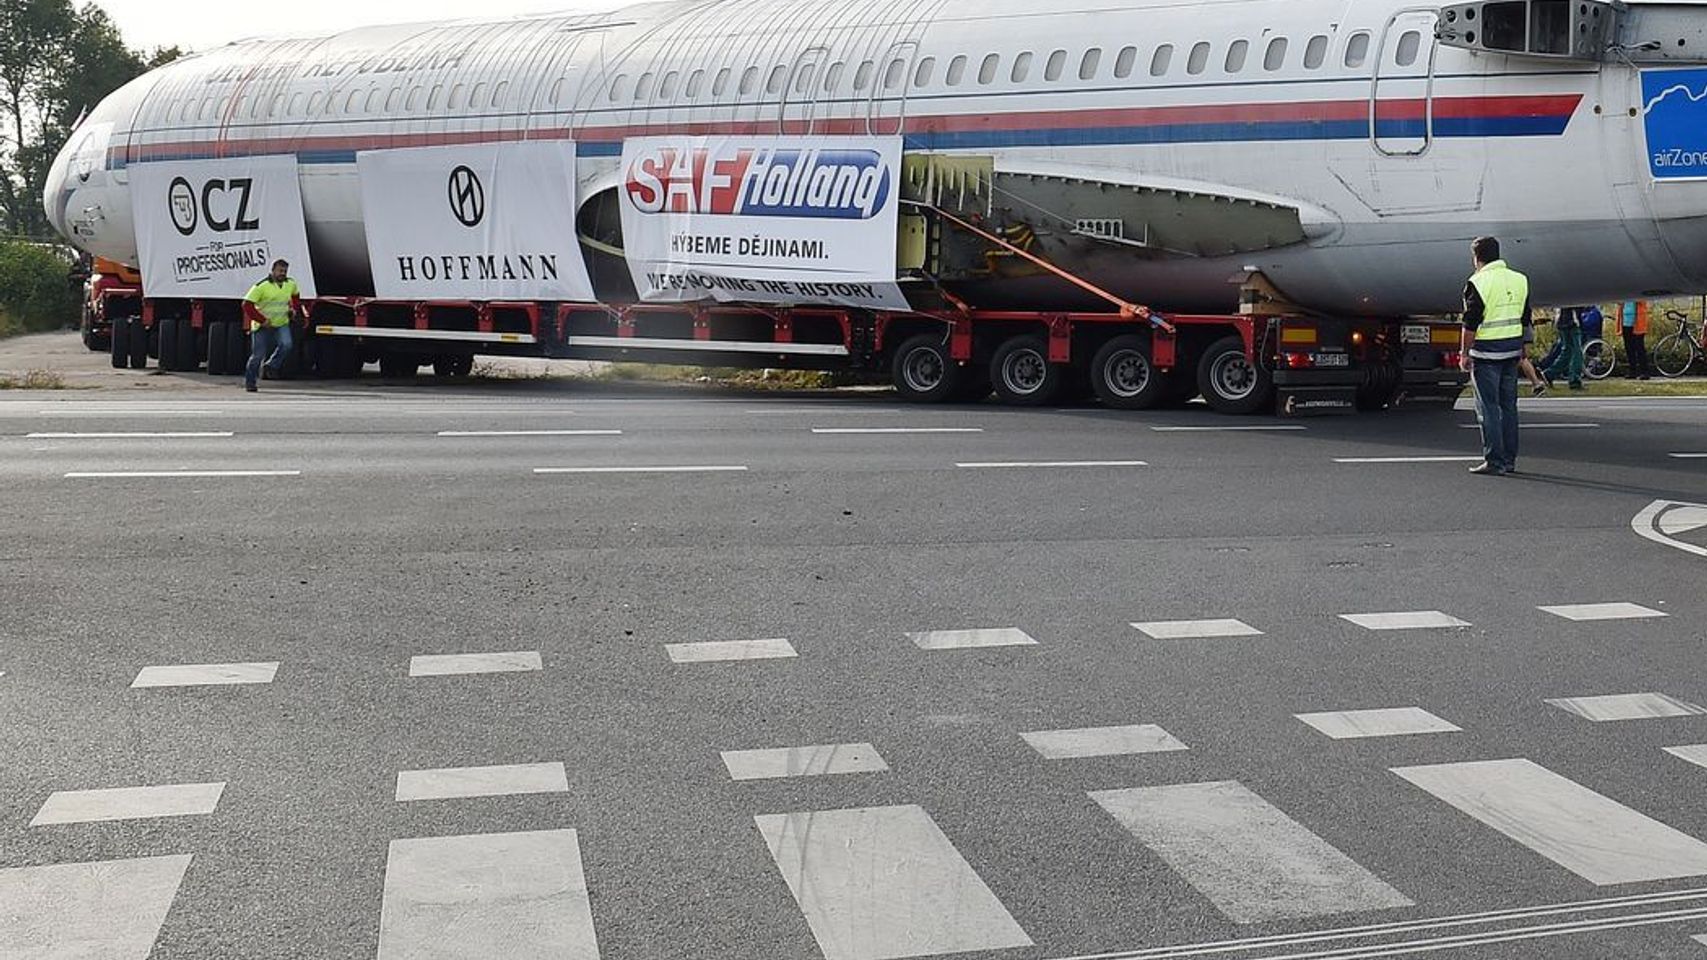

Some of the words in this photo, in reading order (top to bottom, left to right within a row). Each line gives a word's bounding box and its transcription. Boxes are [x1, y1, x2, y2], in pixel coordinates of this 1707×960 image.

[628, 145, 737, 213] SAF
[747, 147, 886, 218] Holland
[202, 178, 259, 232] CZ
[210, 242, 223, 251] FOR
[672, 230, 731, 254] HÝBEME
[738, 234, 829, 259] DĚJINAMI.
[176, 248, 266, 275] PROFESSIONALS
[398, 255, 558, 280] HOFFMANN
[757, 279, 793, 294] THE
[794, 282, 883, 299] HISTORY.
